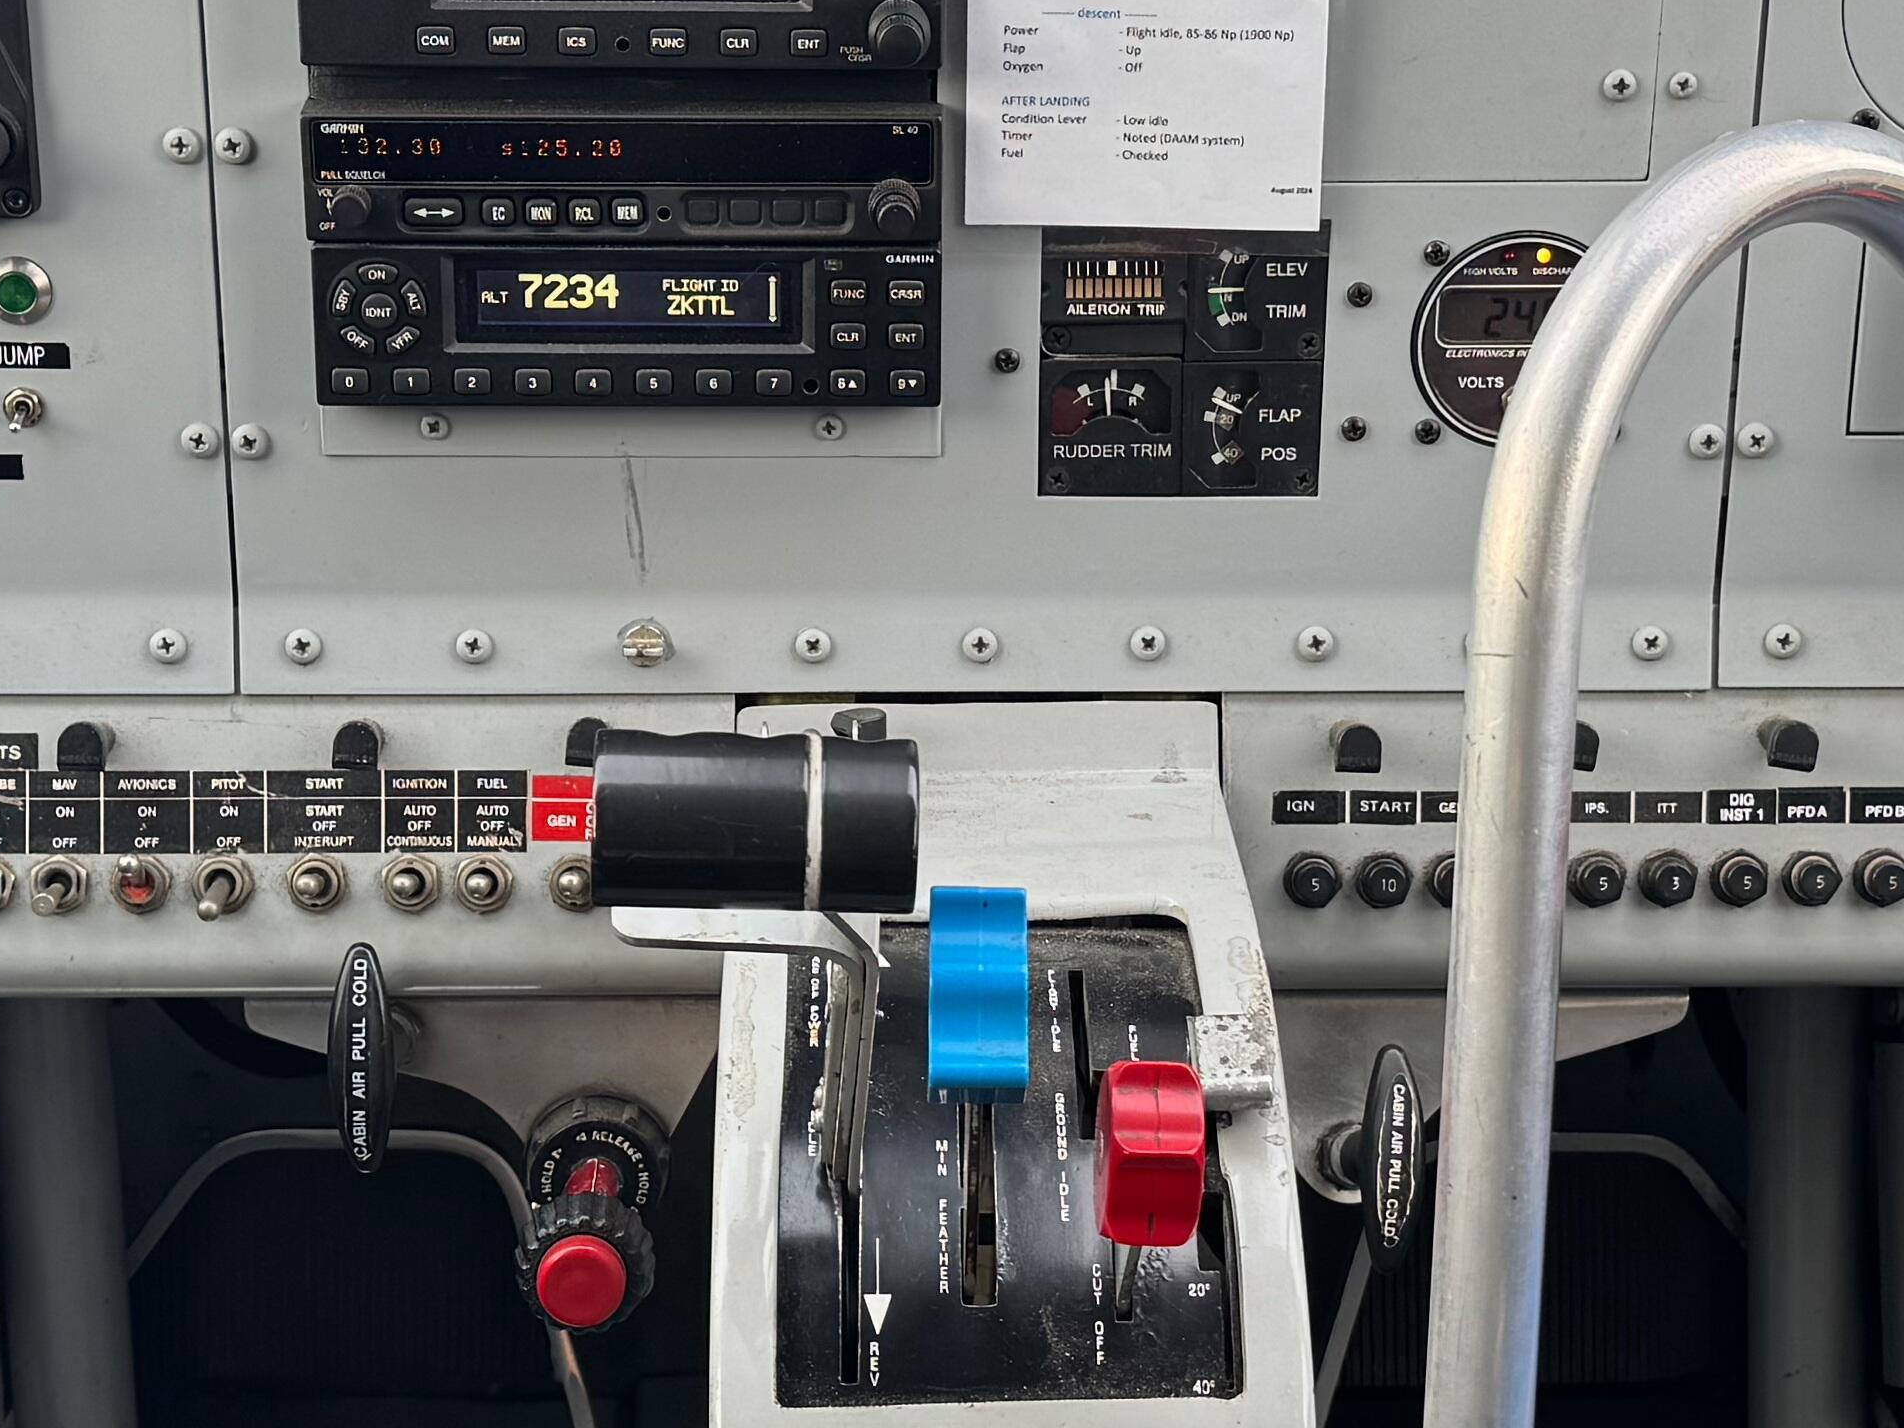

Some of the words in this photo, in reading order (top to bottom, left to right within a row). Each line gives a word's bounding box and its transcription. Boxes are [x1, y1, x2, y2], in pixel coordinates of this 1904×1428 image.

[1266, 263, 1307, 277] ELEV
[518, 274, 619, 309] 7234
[663, 278, 719, 293] FLIGHT
[724, 278, 739, 293] ID
[667, 296, 734, 316] ZKTTL
[1266, 304, 1306, 319] TRIM
[1259, 409, 1301, 423] FLAP
[1054, 444, 1124, 459] RUDDER
[1131, 443, 1171, 458] TRIM
[1261, 447, 1296, 461] POS
[305, 778, 343, 790] START
[477, 778, 507, 790] FUEL
[353, 958, 367, 1006] COLD
[352, 1018, 366, 1060] PULL
[352, 1071, 366, 1099] AIR
[353, 1110, 367, 1161] CABIN
